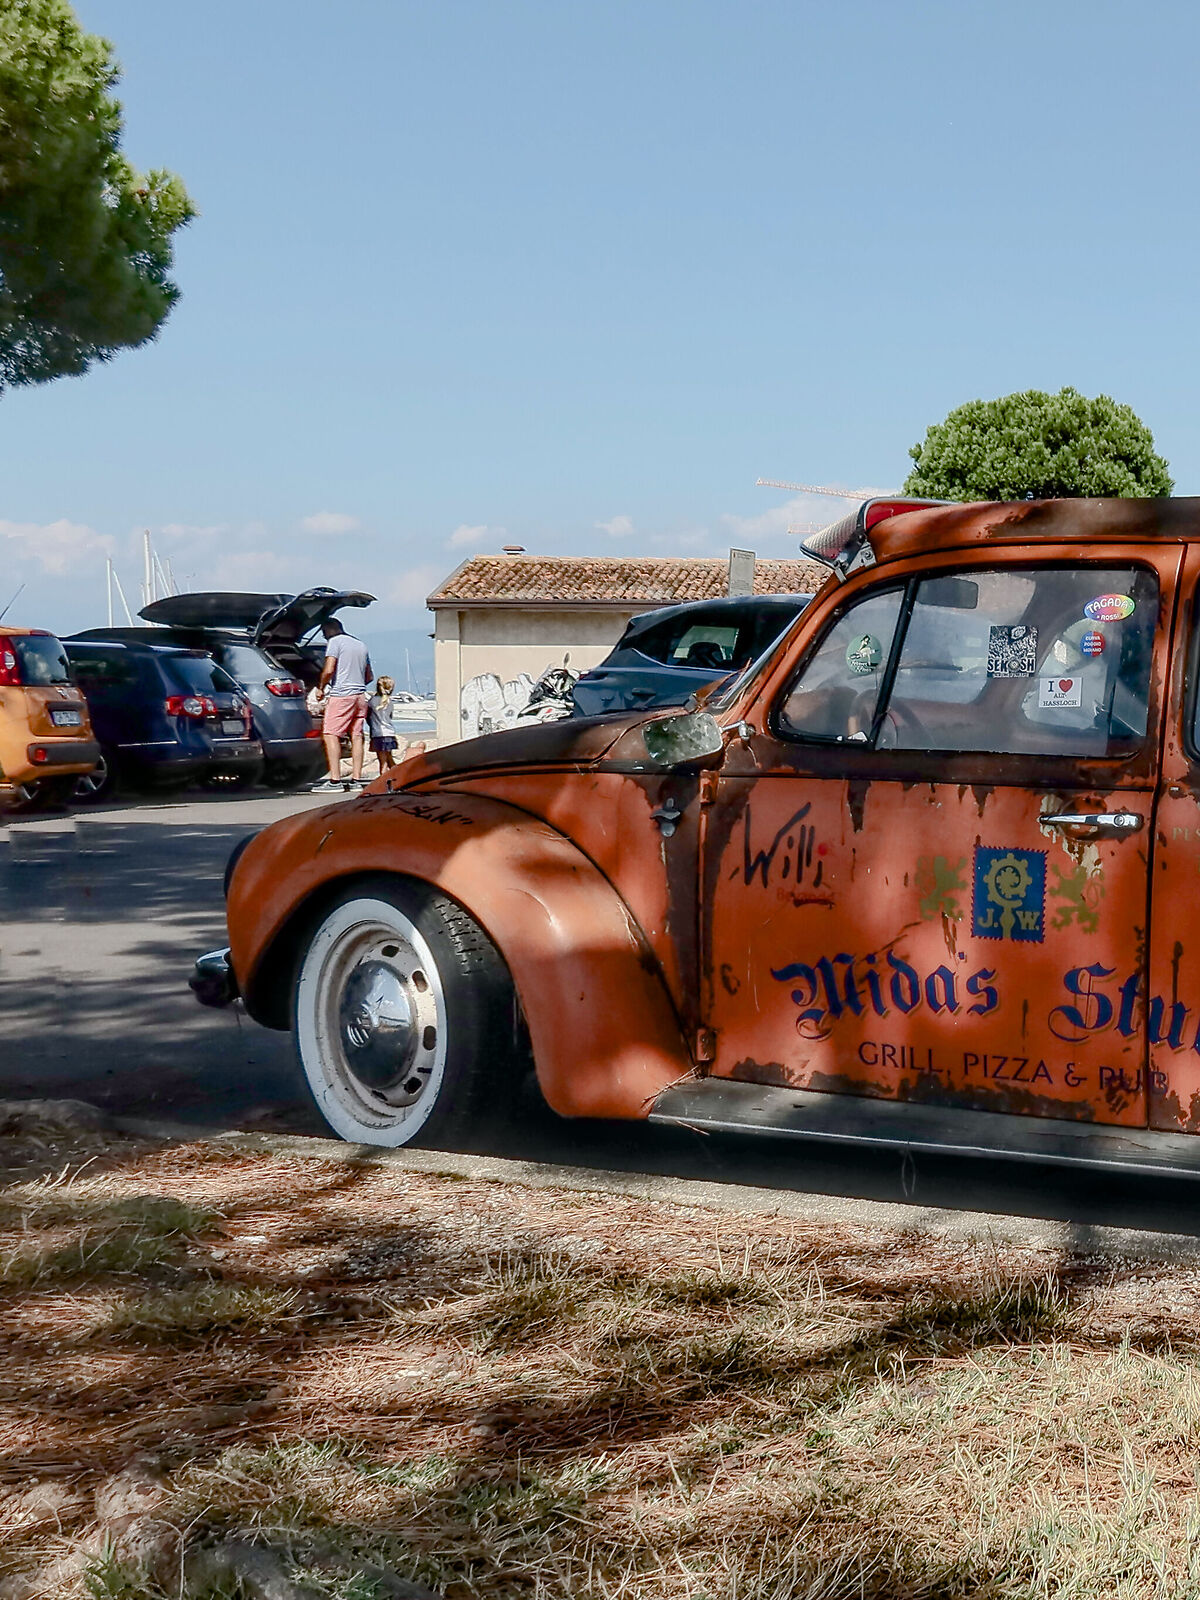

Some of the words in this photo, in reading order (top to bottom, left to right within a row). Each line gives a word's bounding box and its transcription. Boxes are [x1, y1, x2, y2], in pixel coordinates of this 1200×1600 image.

[1086, 598, 1129, 613] TAGADA
[771, 951, 1001, 1041] Midas
[964, 1052, 1053, 1084] PIZZA
[1064, 1062, 1088, 1087] &
[1099, 1066, 1169, 1096] PUB
